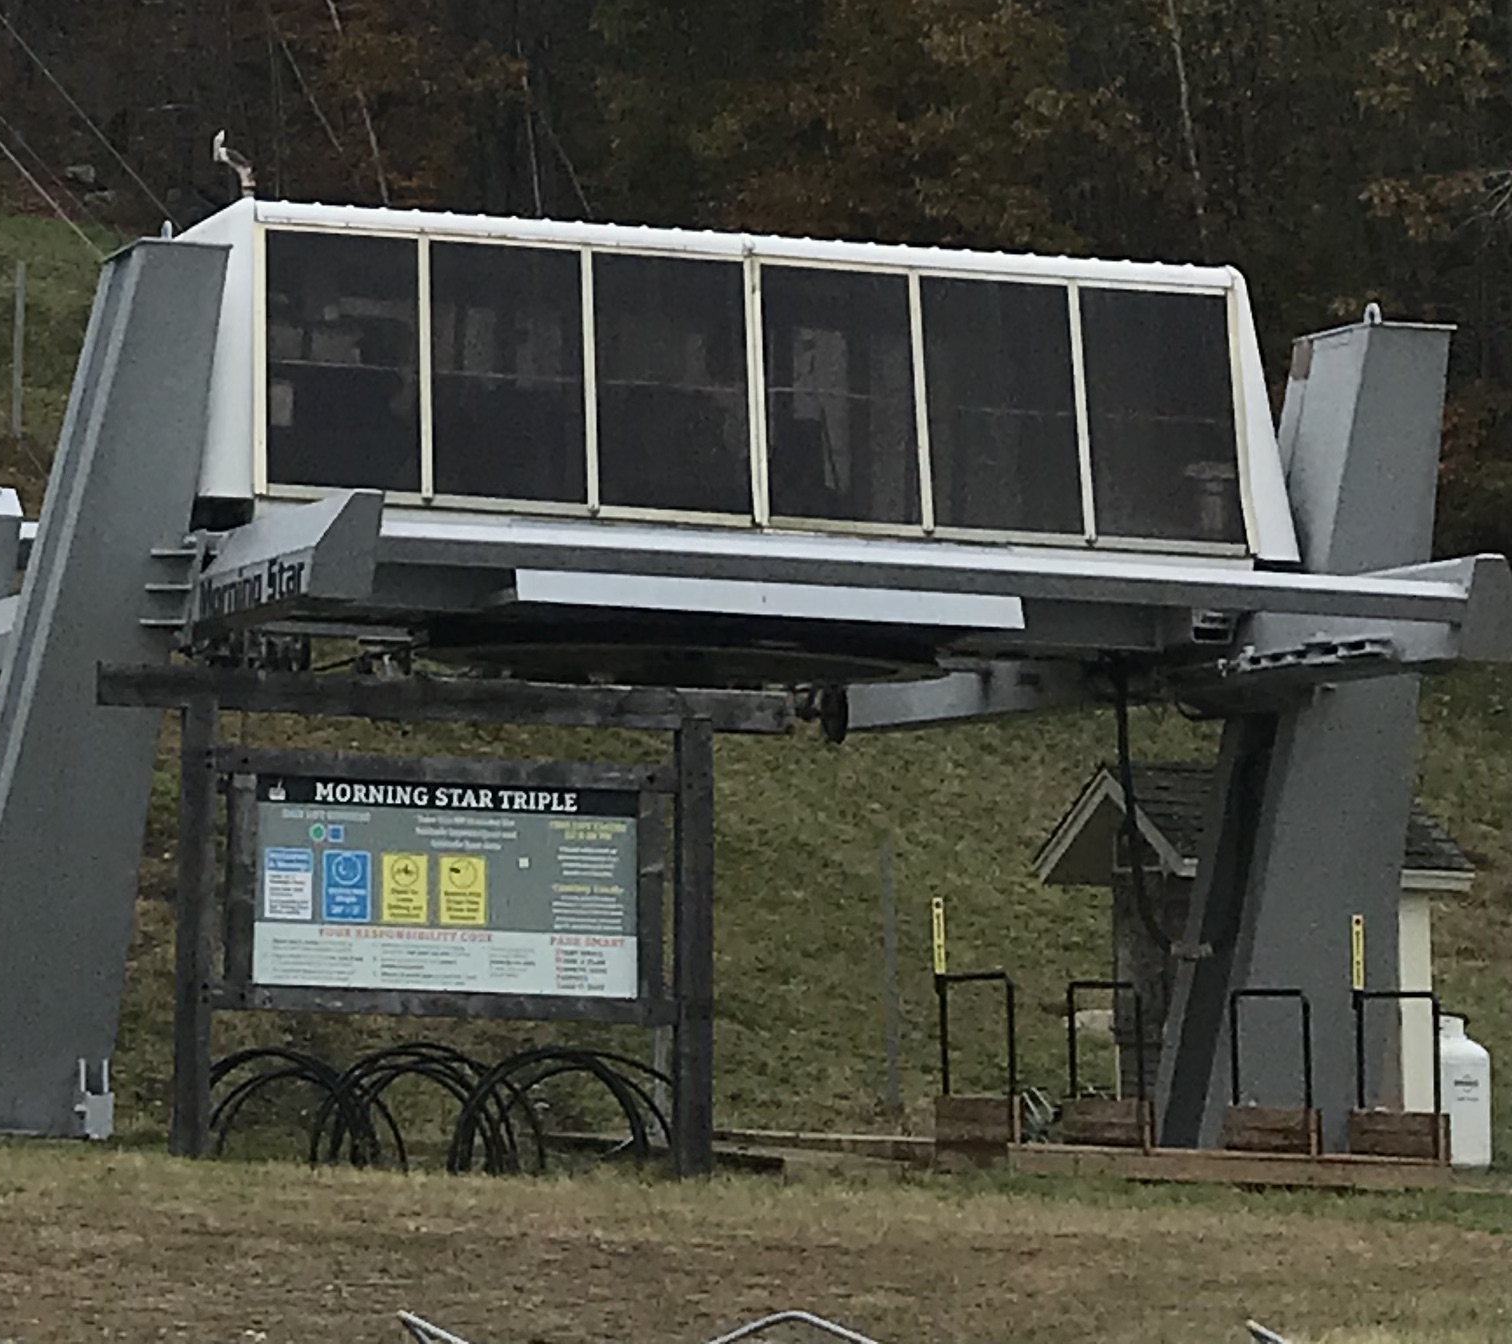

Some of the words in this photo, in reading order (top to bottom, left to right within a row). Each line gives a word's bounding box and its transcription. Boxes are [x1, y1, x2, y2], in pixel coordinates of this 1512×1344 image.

[267, 558, 306, 602] Star
[314, 781, 429, 807] MORNING
[434, 787, 494, 809] STAR
[498, 790, 579, 813] TRIPLE
[355, 928, 457, 942] RESPONSIBILITY
[460, 932, 493, 943] CODE
